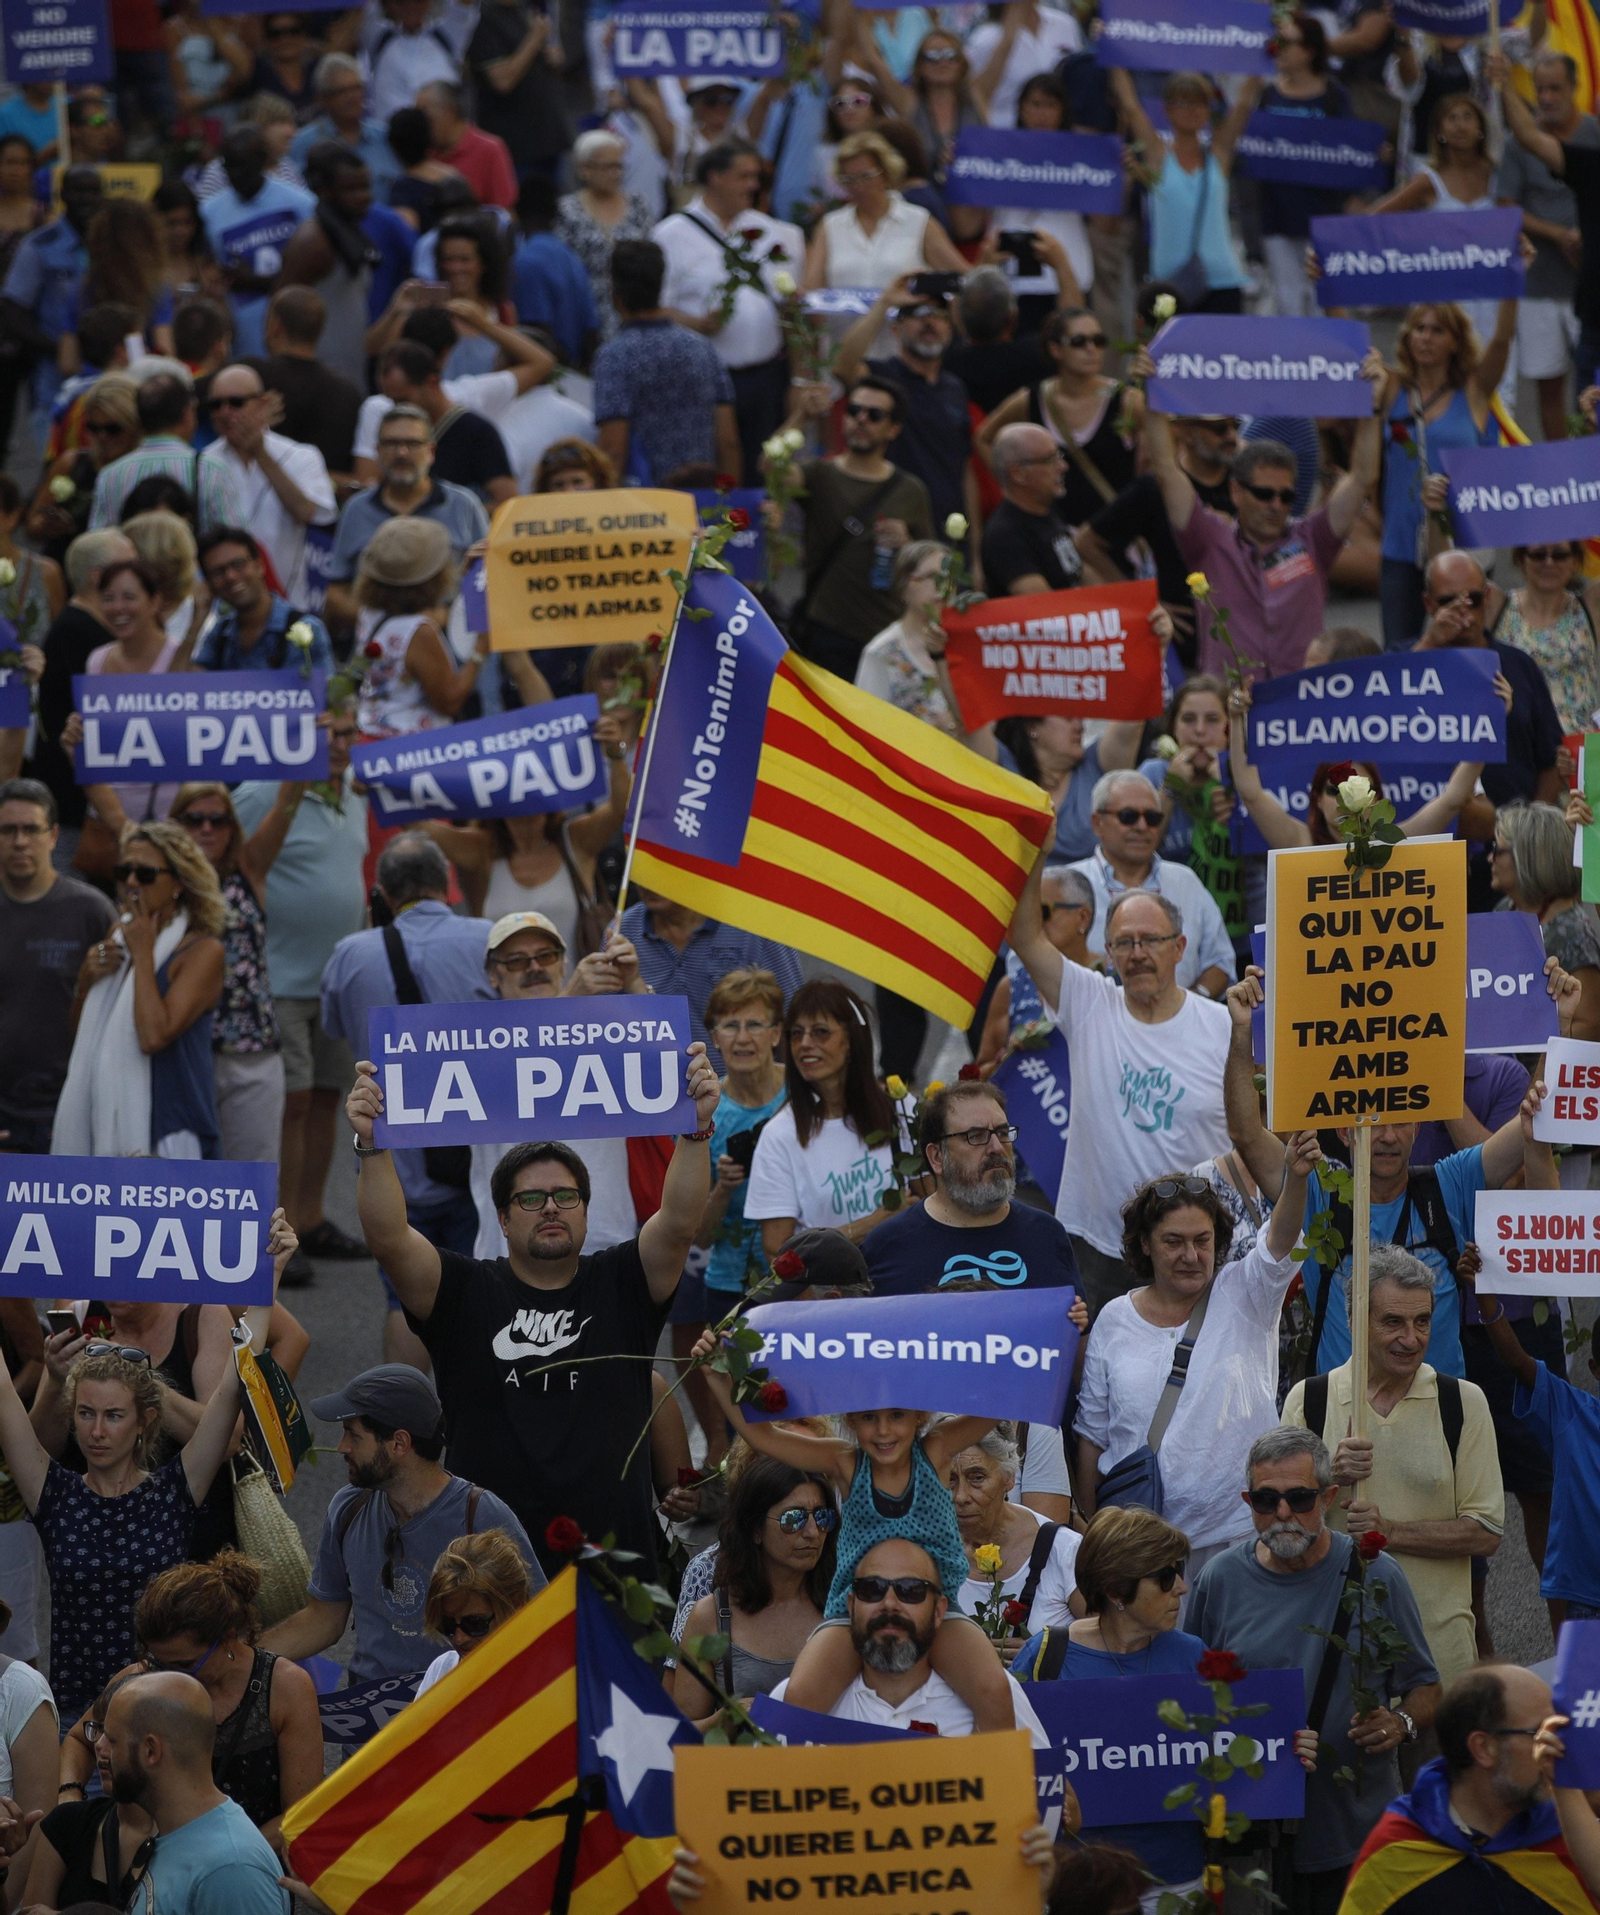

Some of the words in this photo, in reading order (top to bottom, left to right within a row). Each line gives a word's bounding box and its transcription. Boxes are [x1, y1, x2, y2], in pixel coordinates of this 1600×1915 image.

[32, 7, 67, 25] NO
[616, 29, 676, 67] LA
[685, 29, 781, 67] PAU
[1104, 18, 1268, 48] #NoTenimPor
[953, 156, 1116, 186] #NoTenimPor
[247, 220, 298, 246] MILLO
[1324, 244, 1512, 276] #NoTenimPor
[1157, 353, 1360, 381] #NoTenimPor
[1456, 477, 1600, 513] #NoTenim
[514, 516, 592, 537] FELIPE,
[600, 513, 666, 530] QUIEN
[510, 546, 590, 565] QUIERE
[596, 543, 624, 560] LA
[630, 540, 675, 557] PAZ
[527, 576, 559, 593] NO
[566, 570, 660, 590] TRAFICA
[531, 603, 577, 621] CON
[584, 598, 662, 616] ARMAS
[976, 615, 1068, 643] VOLEM
[1068, 608, 1128, 643] PAU,
[981, 644, 1020, 669] NO
[1019, 642, 1126, 672] VENDRE
[1003, 672, 1107, 701] ARMES!
[1298, 673, 1354, 700] NO
[1364, 670, 1391, 697] A
[1401, 668, 1444, 695] LA
[82, 694, 111, 714] LA
[115, 692, 199, 712] MILLOR
[204, 689, 315, 711] RESPOSTA
[673, 598, 756, 838] #NoTenimPor
[83, 717, 166, 768] LA
[186, 713, 317, 767] PAU
[1256, 706, 1497, 747] ISLAMOFÒBIA
[363, 756, 393, 778] LA
[396, 739, 478, 772] MILLOR
[482, 713, 588, 754] RESPOSTA
[371, 772, 458, 814] LA
[467, 735, 597, 809] PAU
[1307, 869, 1435, 902] FELIPE,
[1299, 910, 1362, 939] QUI
[1370, 905, 1444, 934] VOL
[1306, 948, 1353, 975] LA
[1362, 941, 1436, 971] PAU
[1340, 980, 1393, 1009] NO
[1466, 968, 1534, 998] Por
[384, 1032, 417, 1054] LA
[425, 1027, 530, 1052] MILLOR
[538, 1020, 677, 1047] RESPOSTA
[1292, 1013, 1448, 1047] TRAFICA
[1329, 1051, 1409, 1081] AMB
[1558, 1063, 1600, 1089] LES
[384, 1060, 488, 1126] LA
[515, 1050, 680, 1119] PAU
[1305, 1085, 1430, 1118] ARMES
[1554, 1095, 1599, 1121] ELS
[6, 1181, 111, 1206] MILLOR
[120, 1185, 259, 1211] RESPOSTA
[1497, 1215, 1585, 1241] MORTS
[0, 1212, 64, 1276] A
[94, 1215, 259, 1284] PAU
[1499, 1248, 1600, 1274] UERRES,
[512, 1308, 575, 1343] NIKE
[749, 1332, 1060, 1371] #NoTenimPor
[320, 1673, 416, 1712] RESPOS
[320, 1692, 416, 1736] PA
[1065, 1731, 1285, 1773] oTenimPr
[726, 1786, 860, 1815] FELIPE,
[870, 1777, 985, 1809] QUIEN
[719, 1830, 855, 1860] QUIERE
[865, 1827, 913, 1853] LA
[922, 1822, 997, 1849] PAZ
[747, 1877, 801, 1902] NO
[811, 1868, 972, 1899] TRAFICA
